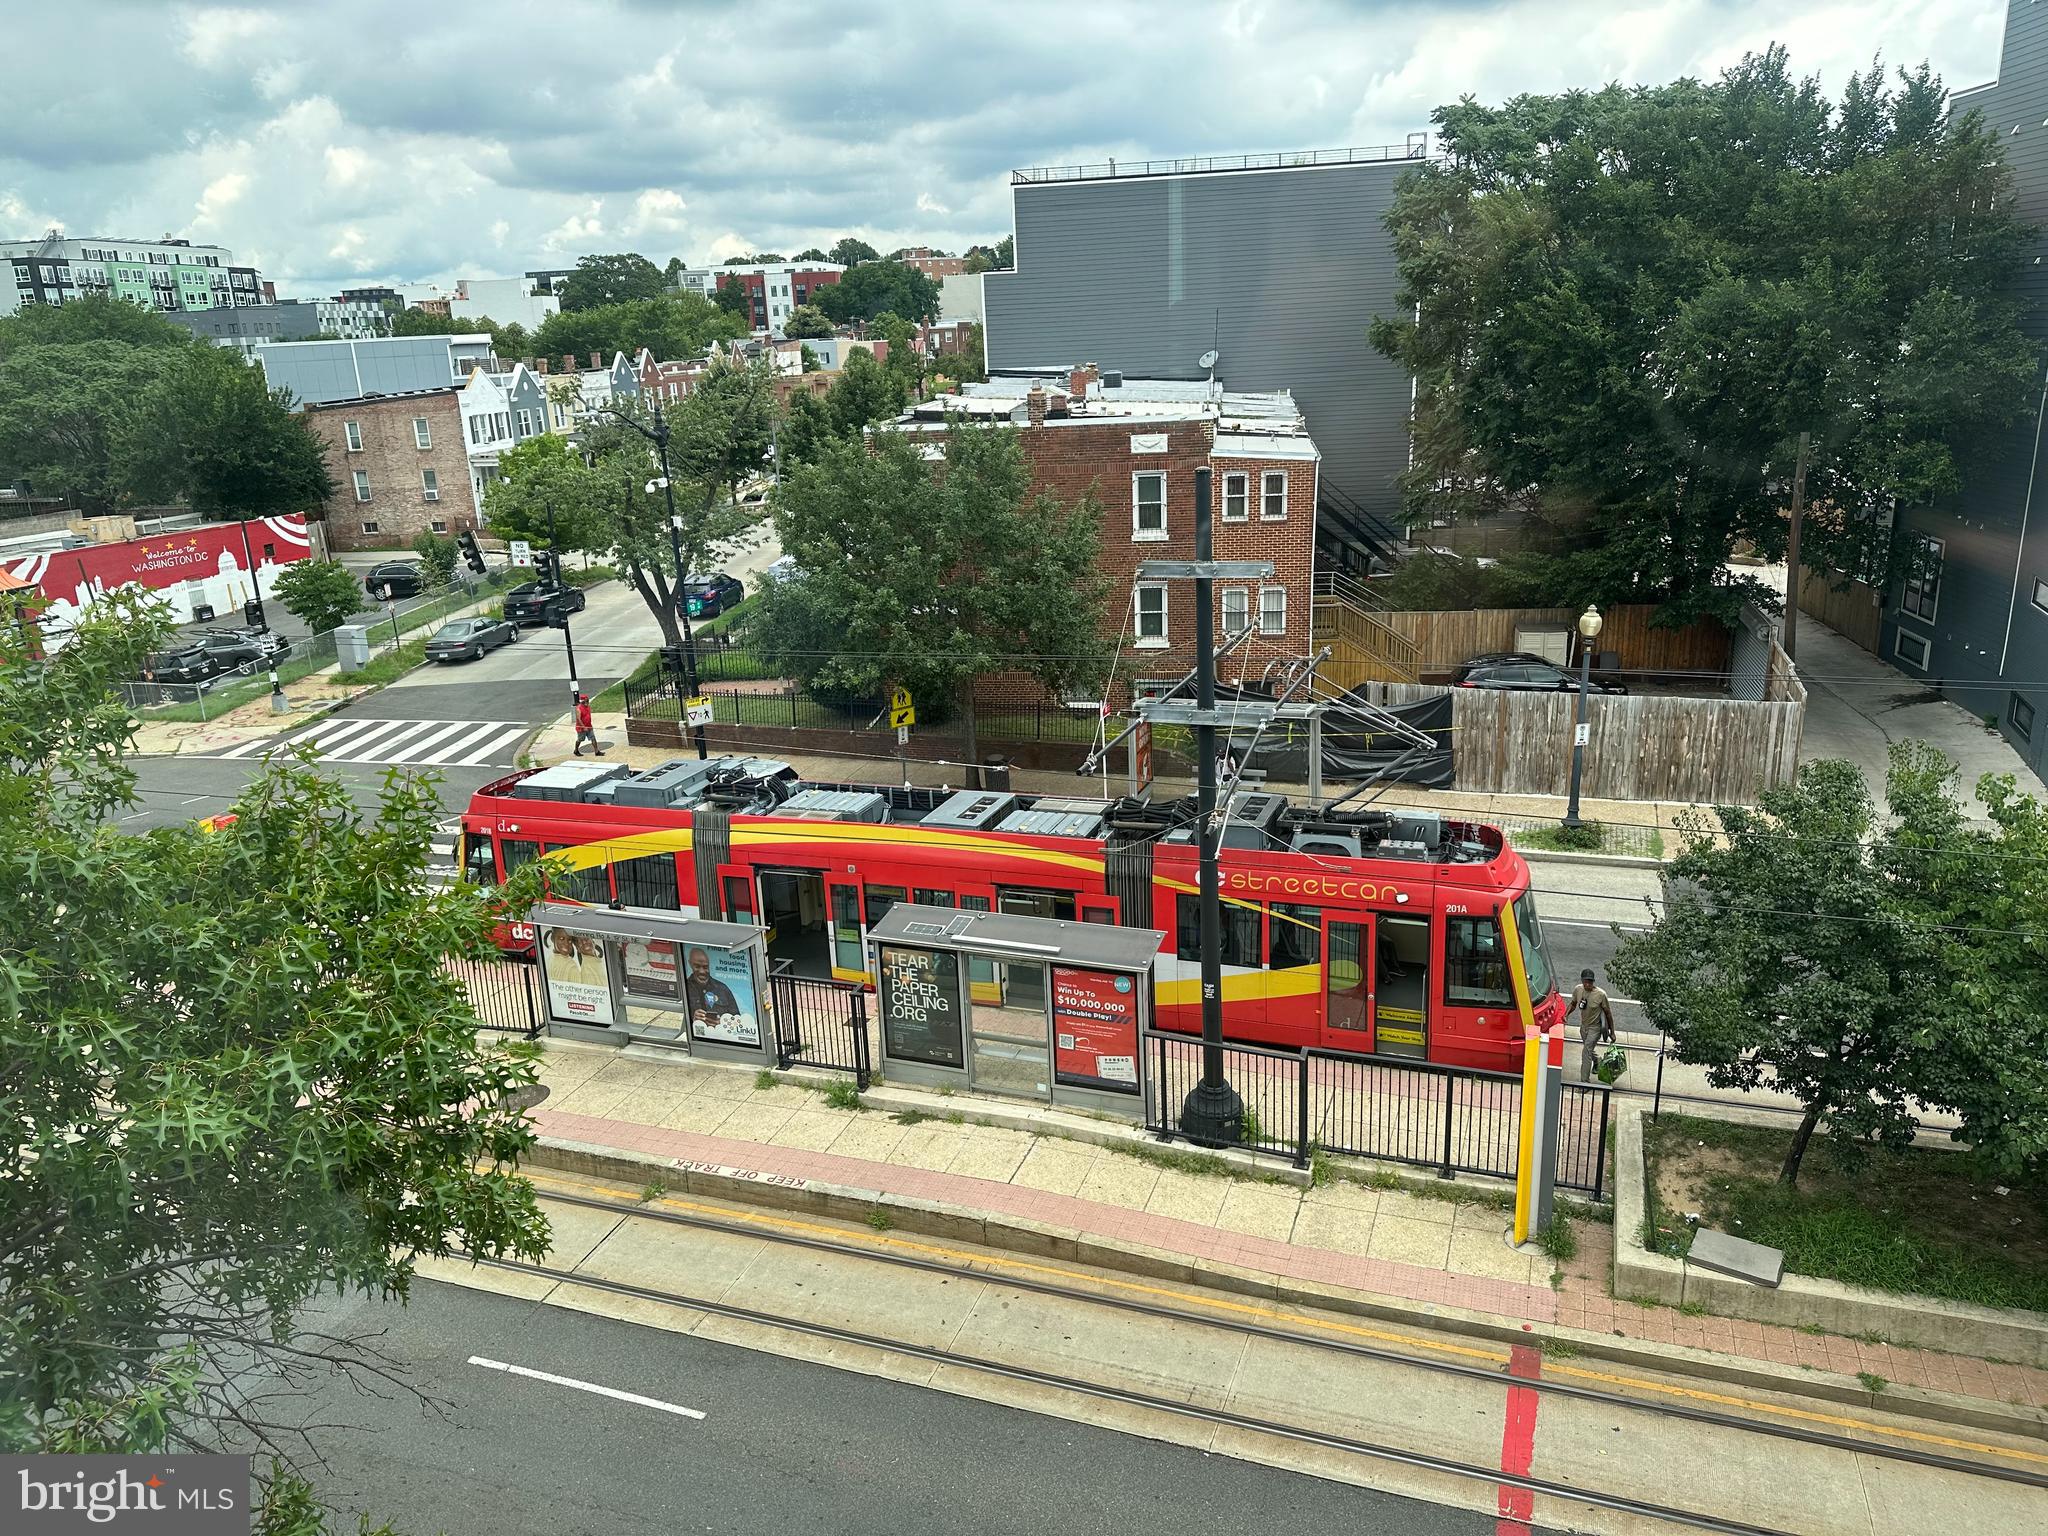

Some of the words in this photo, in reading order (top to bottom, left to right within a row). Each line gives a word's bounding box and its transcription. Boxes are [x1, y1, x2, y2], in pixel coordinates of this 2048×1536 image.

[146, 548, 183, 560] Welcome
[184, 545, 197, 553] to
[131, 554, 193, 573] WASHINGTON
[194, 551, 209, 562] DC
[1230, 870, 1398, 901] streetcar
[1445, 904, 1468, 913] 201A
[512, 923, 534, 940] dc
[719, 959, 748, 969] housing,
[729, 953, 747, 962] food,
[888, 951, 929, 970] TEAR
[729, 967, 749, 975] more,
[889, 964, 919, 982] THE
[551, 982, 564, 990] The
[564, 984, 582, 993] other
[583, 987, 609, 997] person
[891, 978, 939, 998] PAPER
[1057, 986, 1072, 995] Win
[1073, 989, 1085, 997] Up
[1085, 990, 1096, 998] To
[558, 992, 577, 1001] might
[891, 991, 949, 1012] CEILING
[1057, 994, 1125, 1013] $10,000,000
[569, 1003, 594, 1011] LISTENING
[890, 1004, 927, 1022] .ORG
[1066, 1008, 1092, 1018] Double
[1093, 1012, 1112, 1021] Play!
[736, 1026, 757, 1035] LinkU
[674, 1159, 721, 1174] TRACK
[729, 1168, 759, 1180] OFF
[767, 1174, 807, 1188] KEEP
